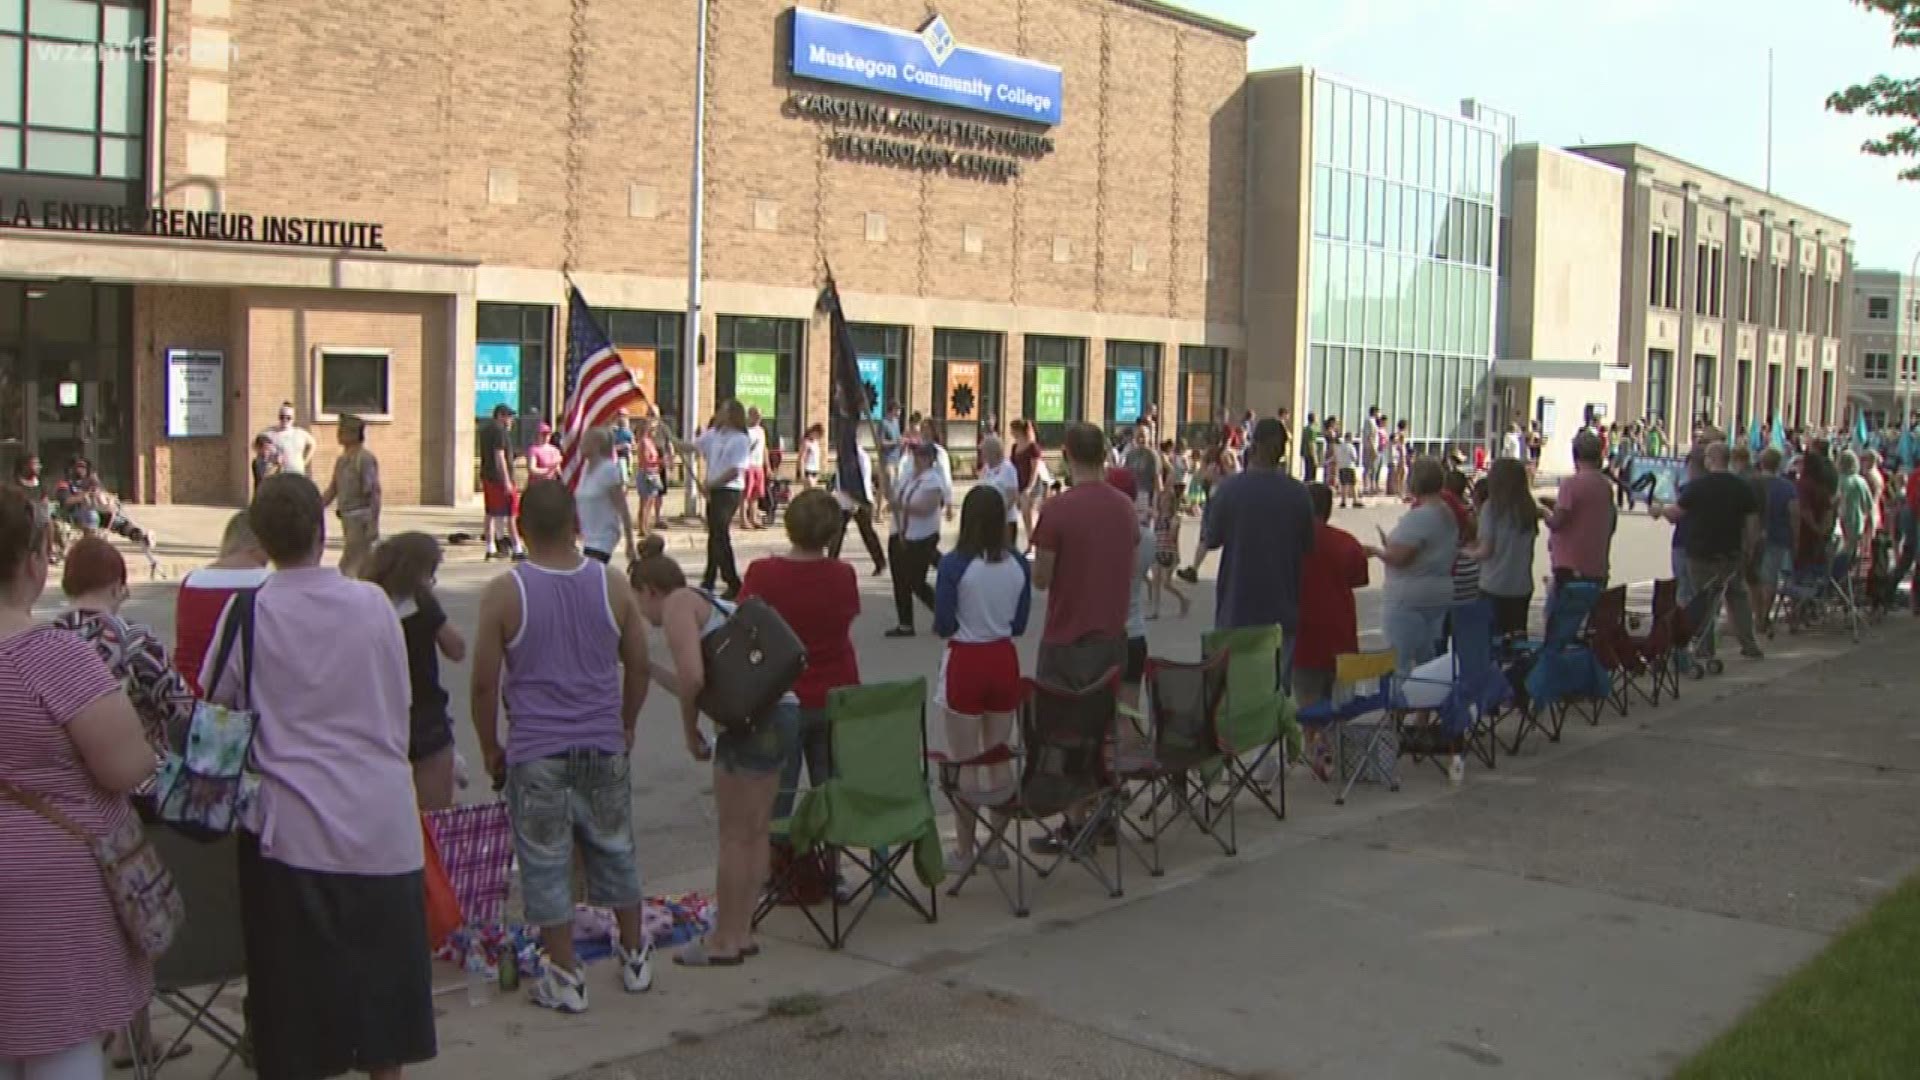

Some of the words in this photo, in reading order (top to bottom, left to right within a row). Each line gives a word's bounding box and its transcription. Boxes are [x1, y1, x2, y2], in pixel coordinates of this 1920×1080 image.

[808, 44, 898, 80] Muskegon
[902, 63, 993, 102] Community
[996, 82, 1052, 114] College
[43, 200, 253, 242] ENTREPRENEUR
[263, 215, 385, 249] INSTITUTE
